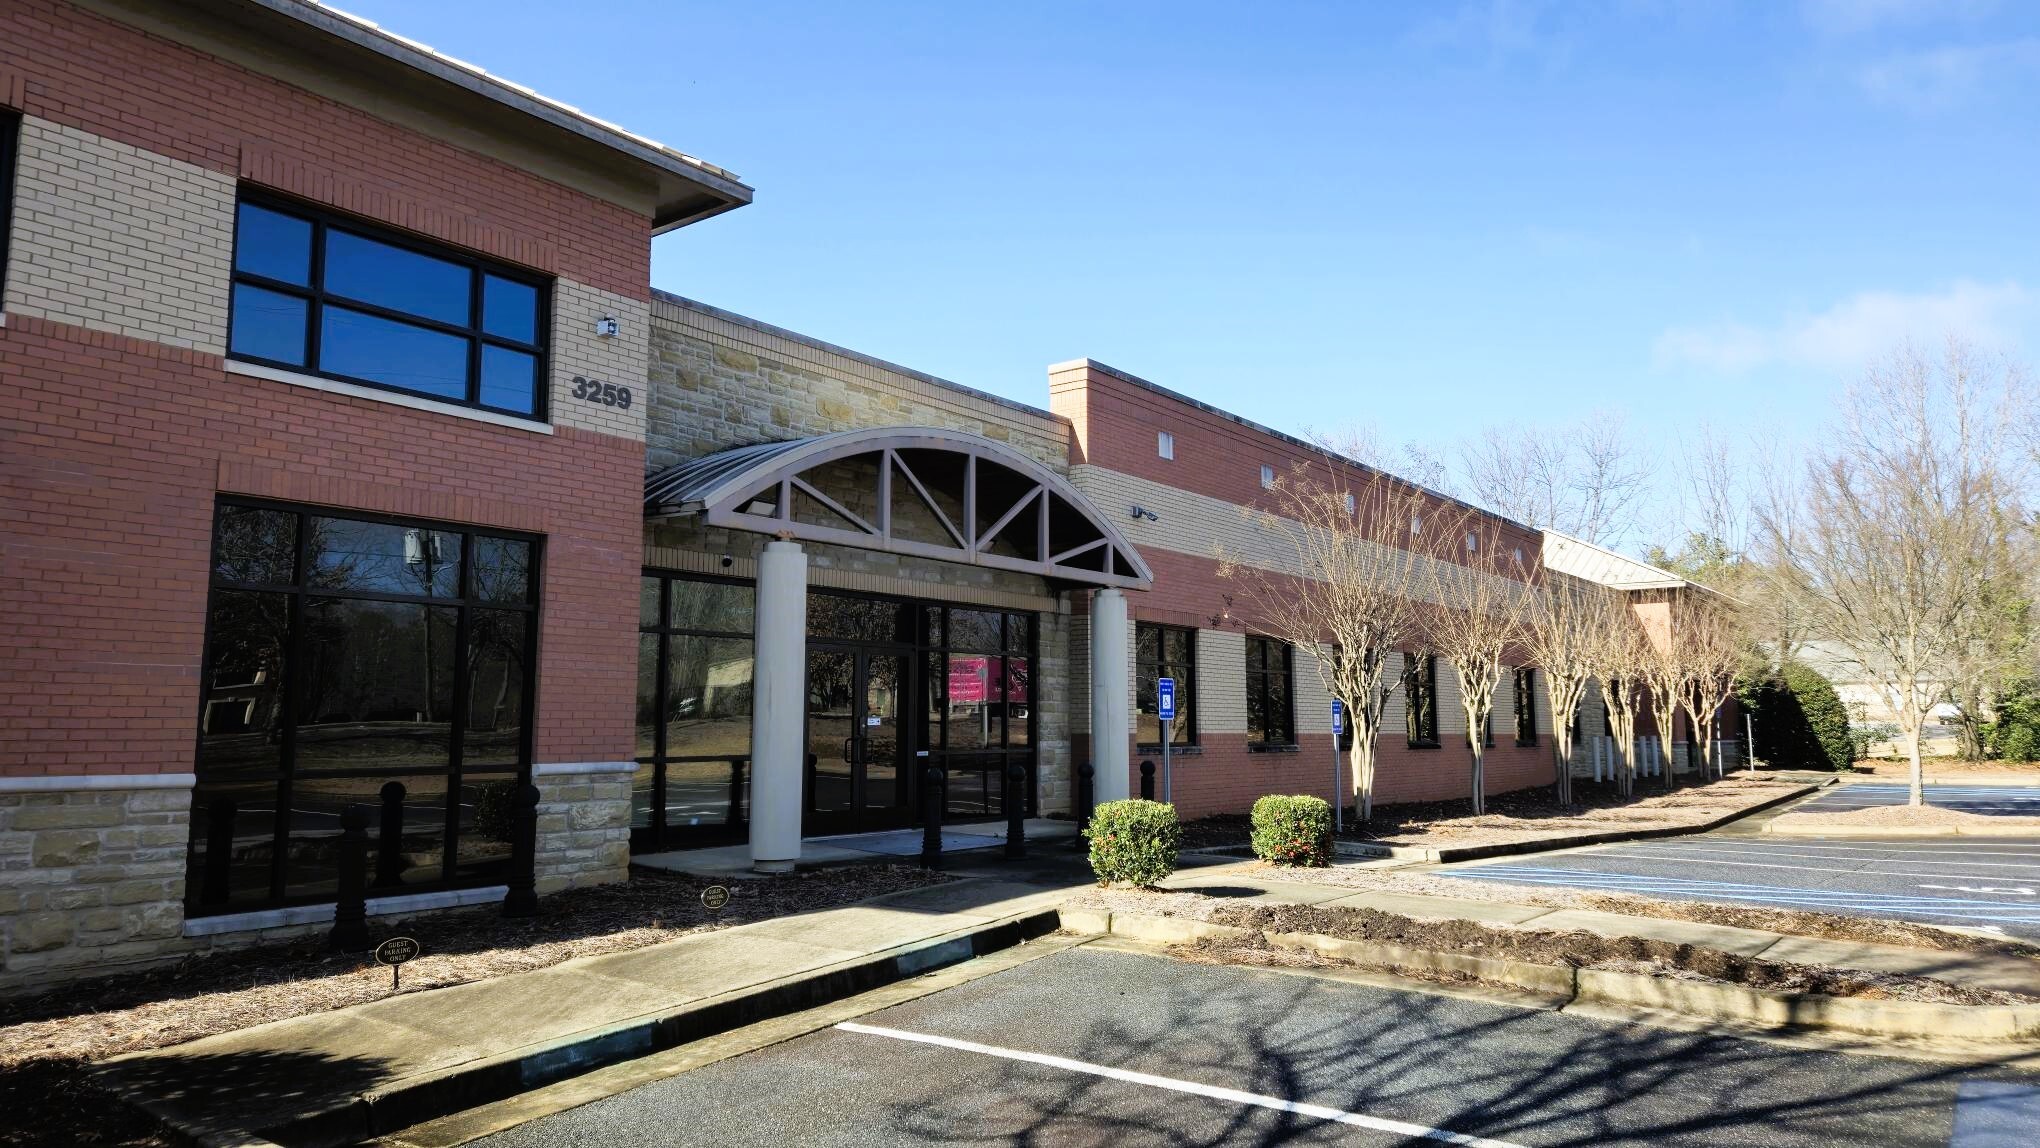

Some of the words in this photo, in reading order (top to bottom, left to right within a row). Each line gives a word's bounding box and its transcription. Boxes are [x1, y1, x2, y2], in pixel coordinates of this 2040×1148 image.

[572, 376, 631, 409] 3259
[388, 940, 409, 949] GUEST
[384, 947, 411, 956] PARKING
